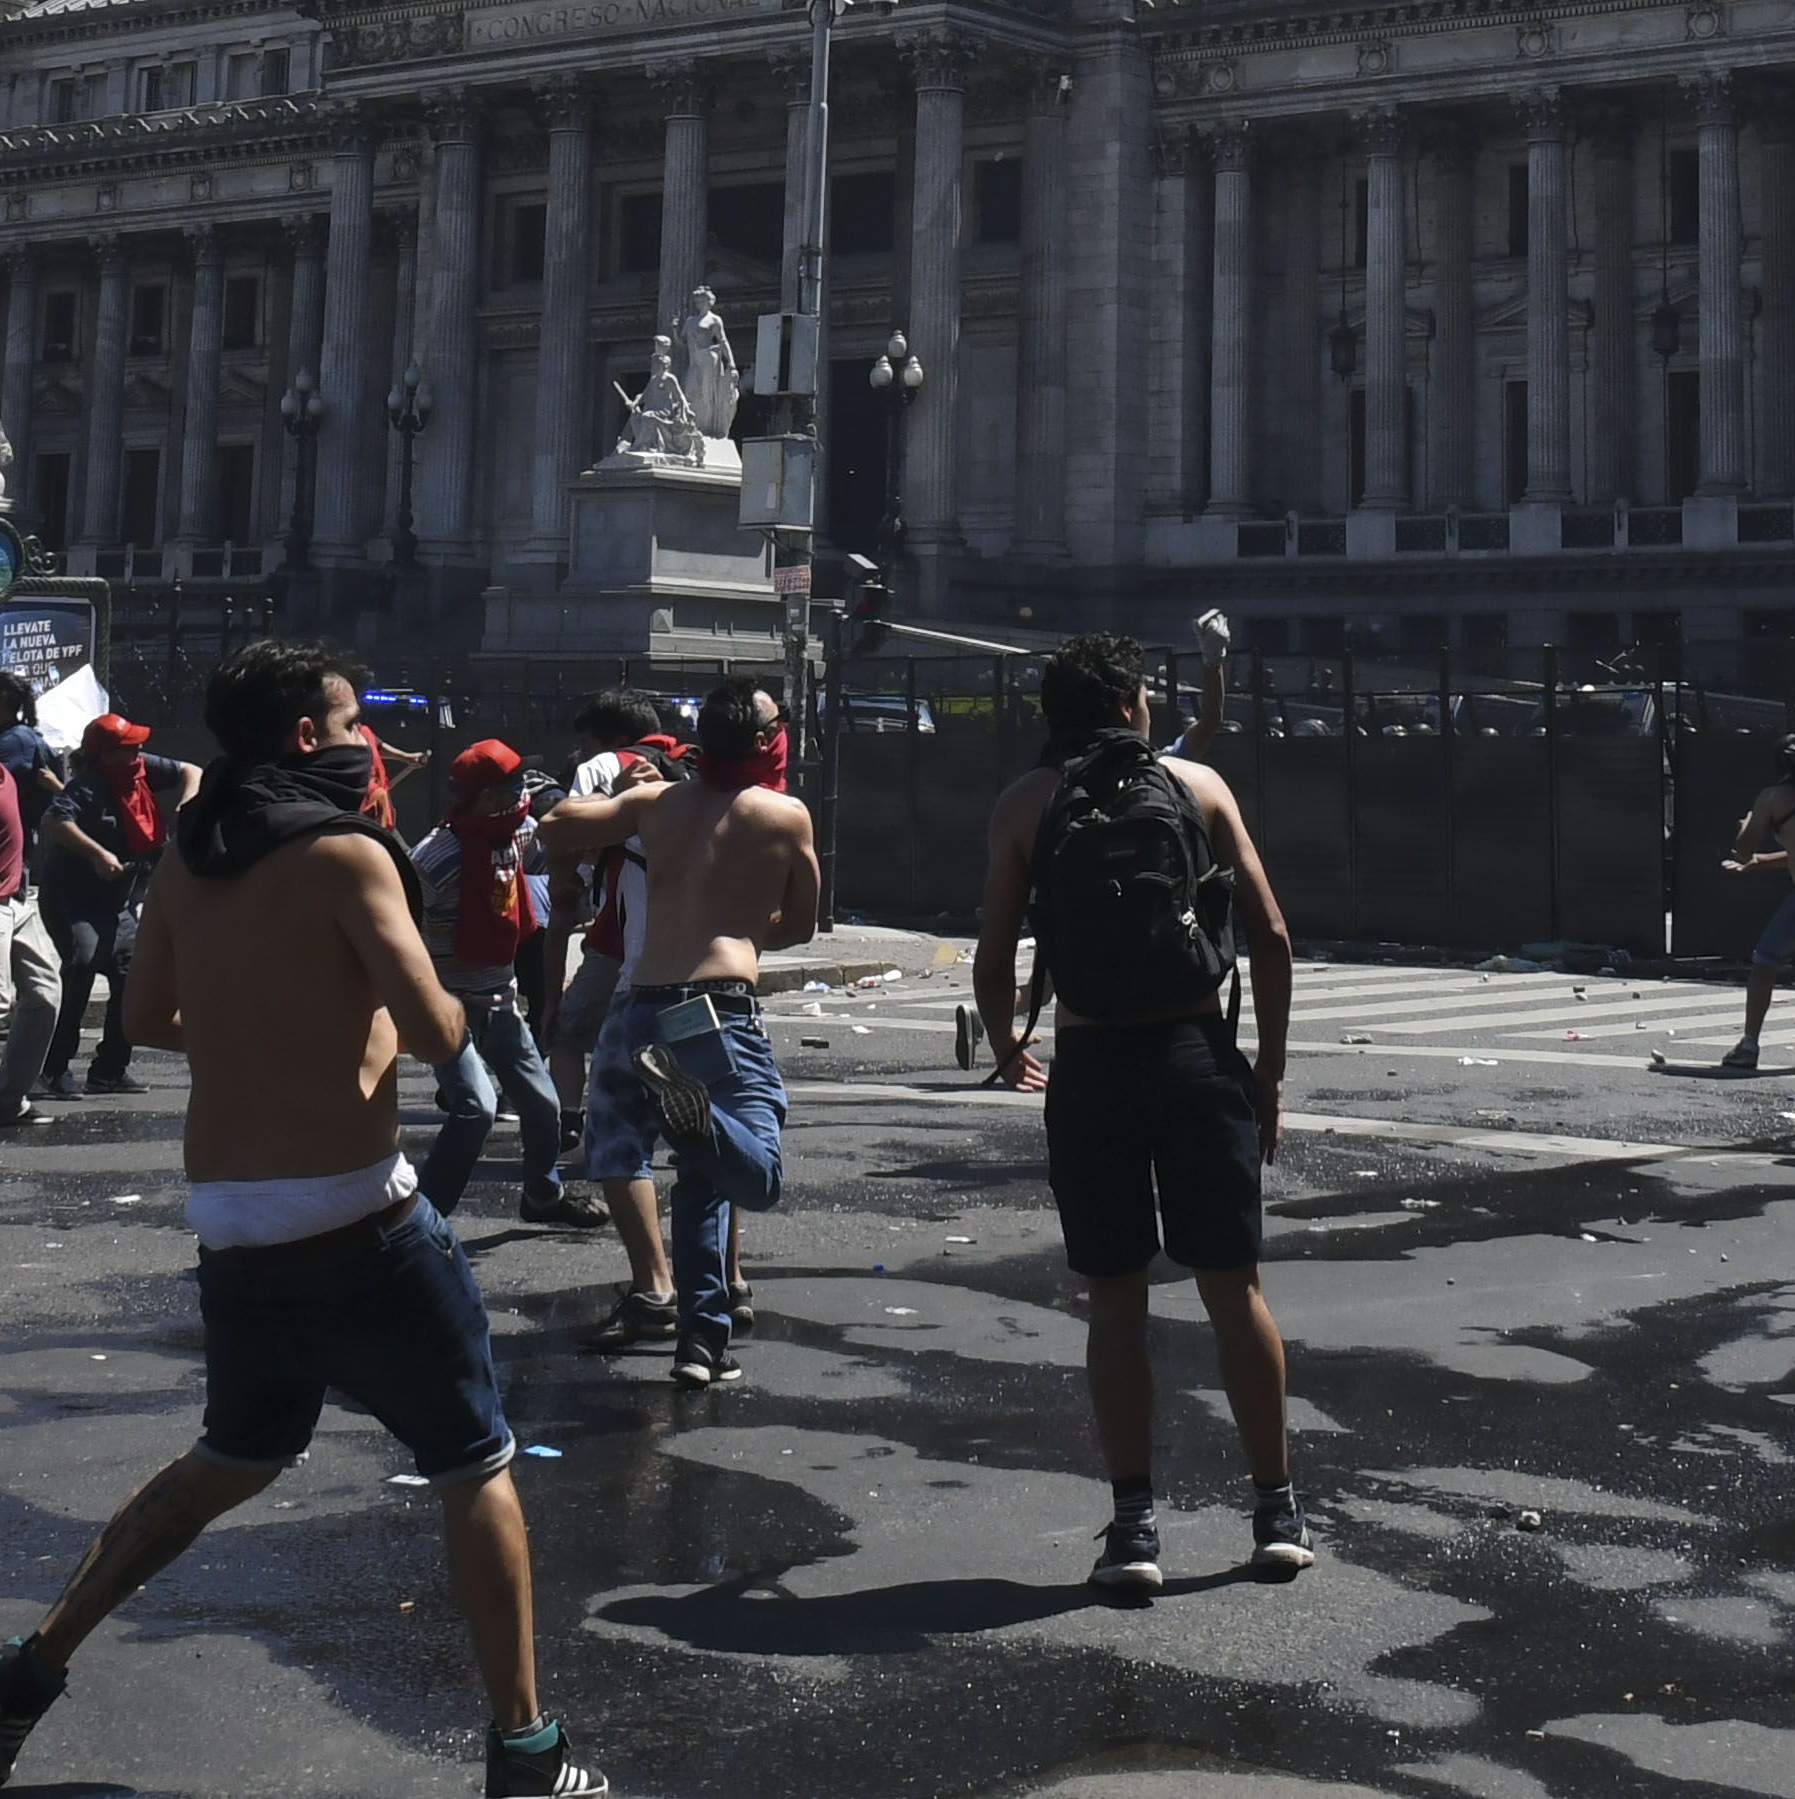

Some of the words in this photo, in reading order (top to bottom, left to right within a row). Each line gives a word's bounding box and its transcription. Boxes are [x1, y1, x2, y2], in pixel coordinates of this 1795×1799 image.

[486, 3, 620, 41] CONGRESO
[3, 620, 52, 636] LLEVATE
[20, 634, 56, 648] NUEVA
[46, 647, 61, 660] DE
[62, 644, 84, 658] YPF
